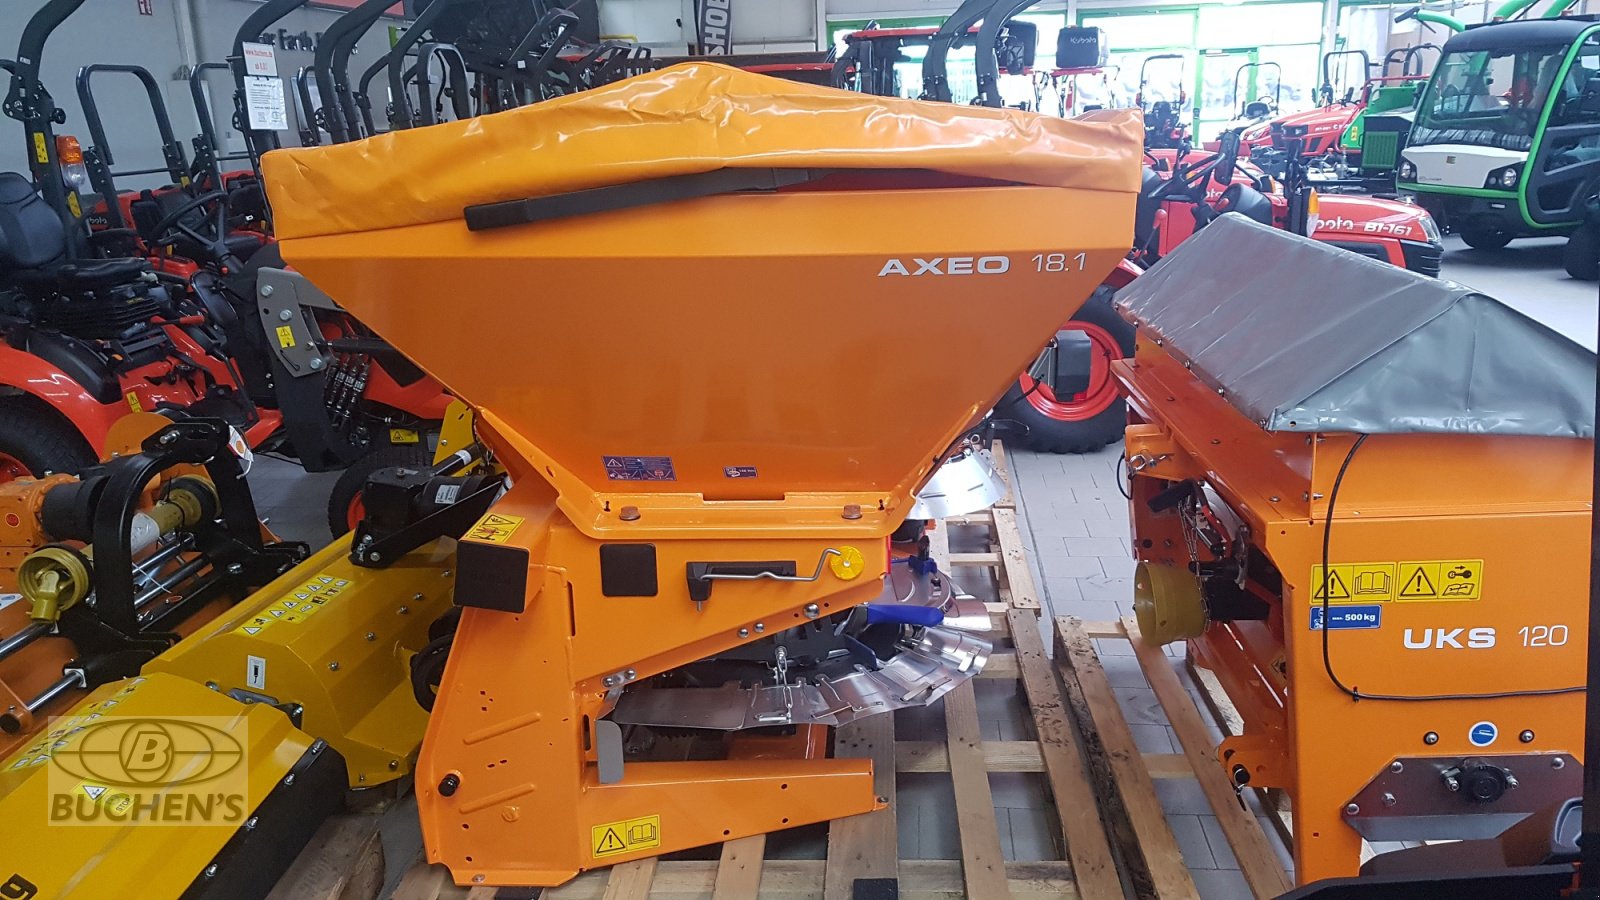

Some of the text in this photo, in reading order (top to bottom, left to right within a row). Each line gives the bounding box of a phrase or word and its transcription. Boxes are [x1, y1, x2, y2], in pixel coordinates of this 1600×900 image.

[877, 252, 1086, 277] AXEO 18.1
[1344, 613, 1363, 621] 500
[1363, 613, 1376, 622] kg
[1403, 624, 1569, 649] UKS 120
